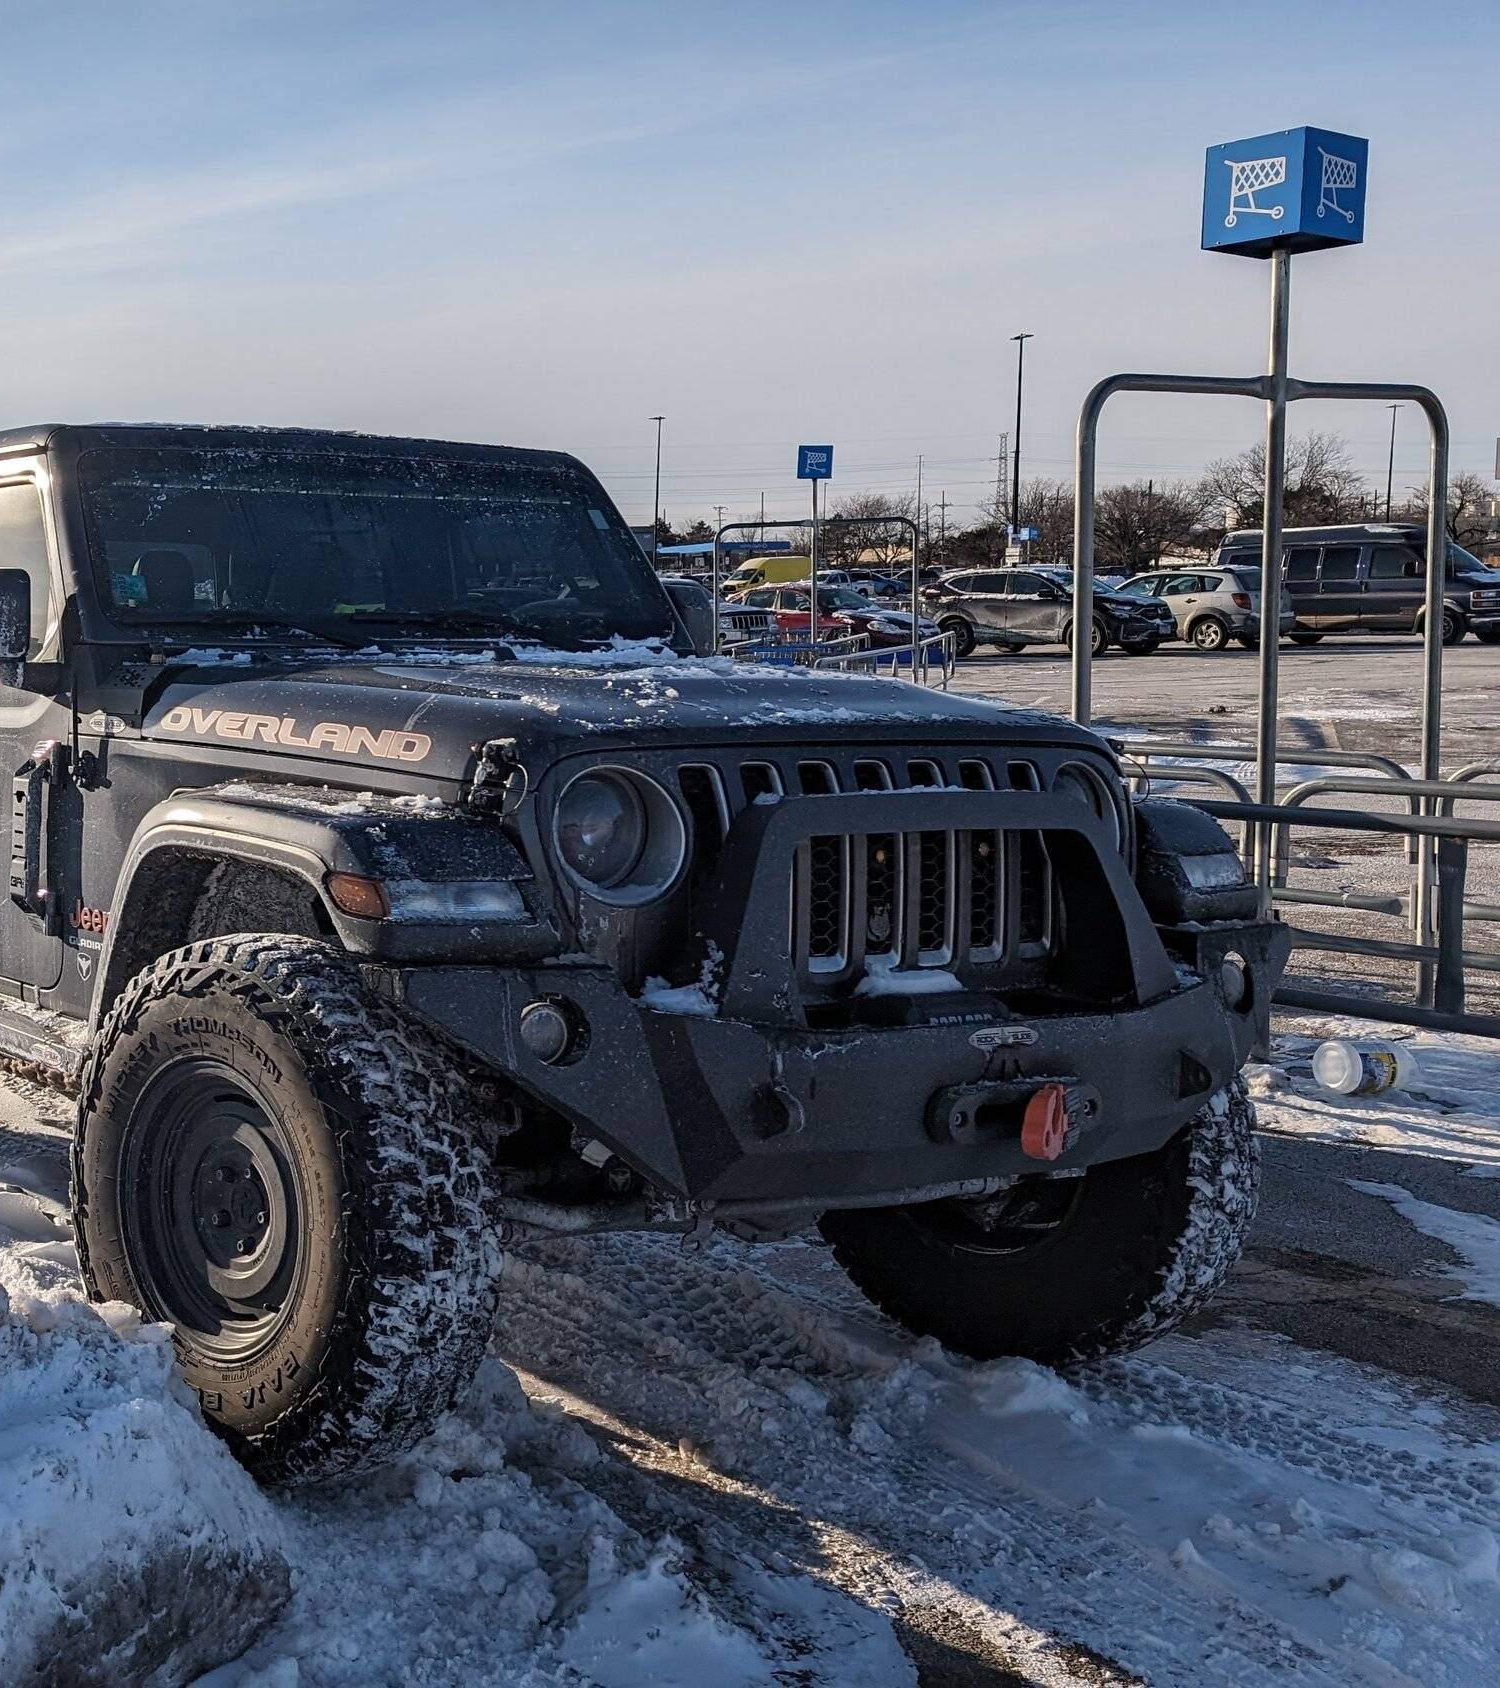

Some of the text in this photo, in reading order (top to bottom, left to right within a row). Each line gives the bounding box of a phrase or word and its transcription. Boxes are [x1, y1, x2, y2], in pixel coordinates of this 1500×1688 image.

[160, 706, 432, 762] OVERLAND
[167, 1015, 283, 1084] THOMPSON
[235, 1350, 301, 1409] BAJA
